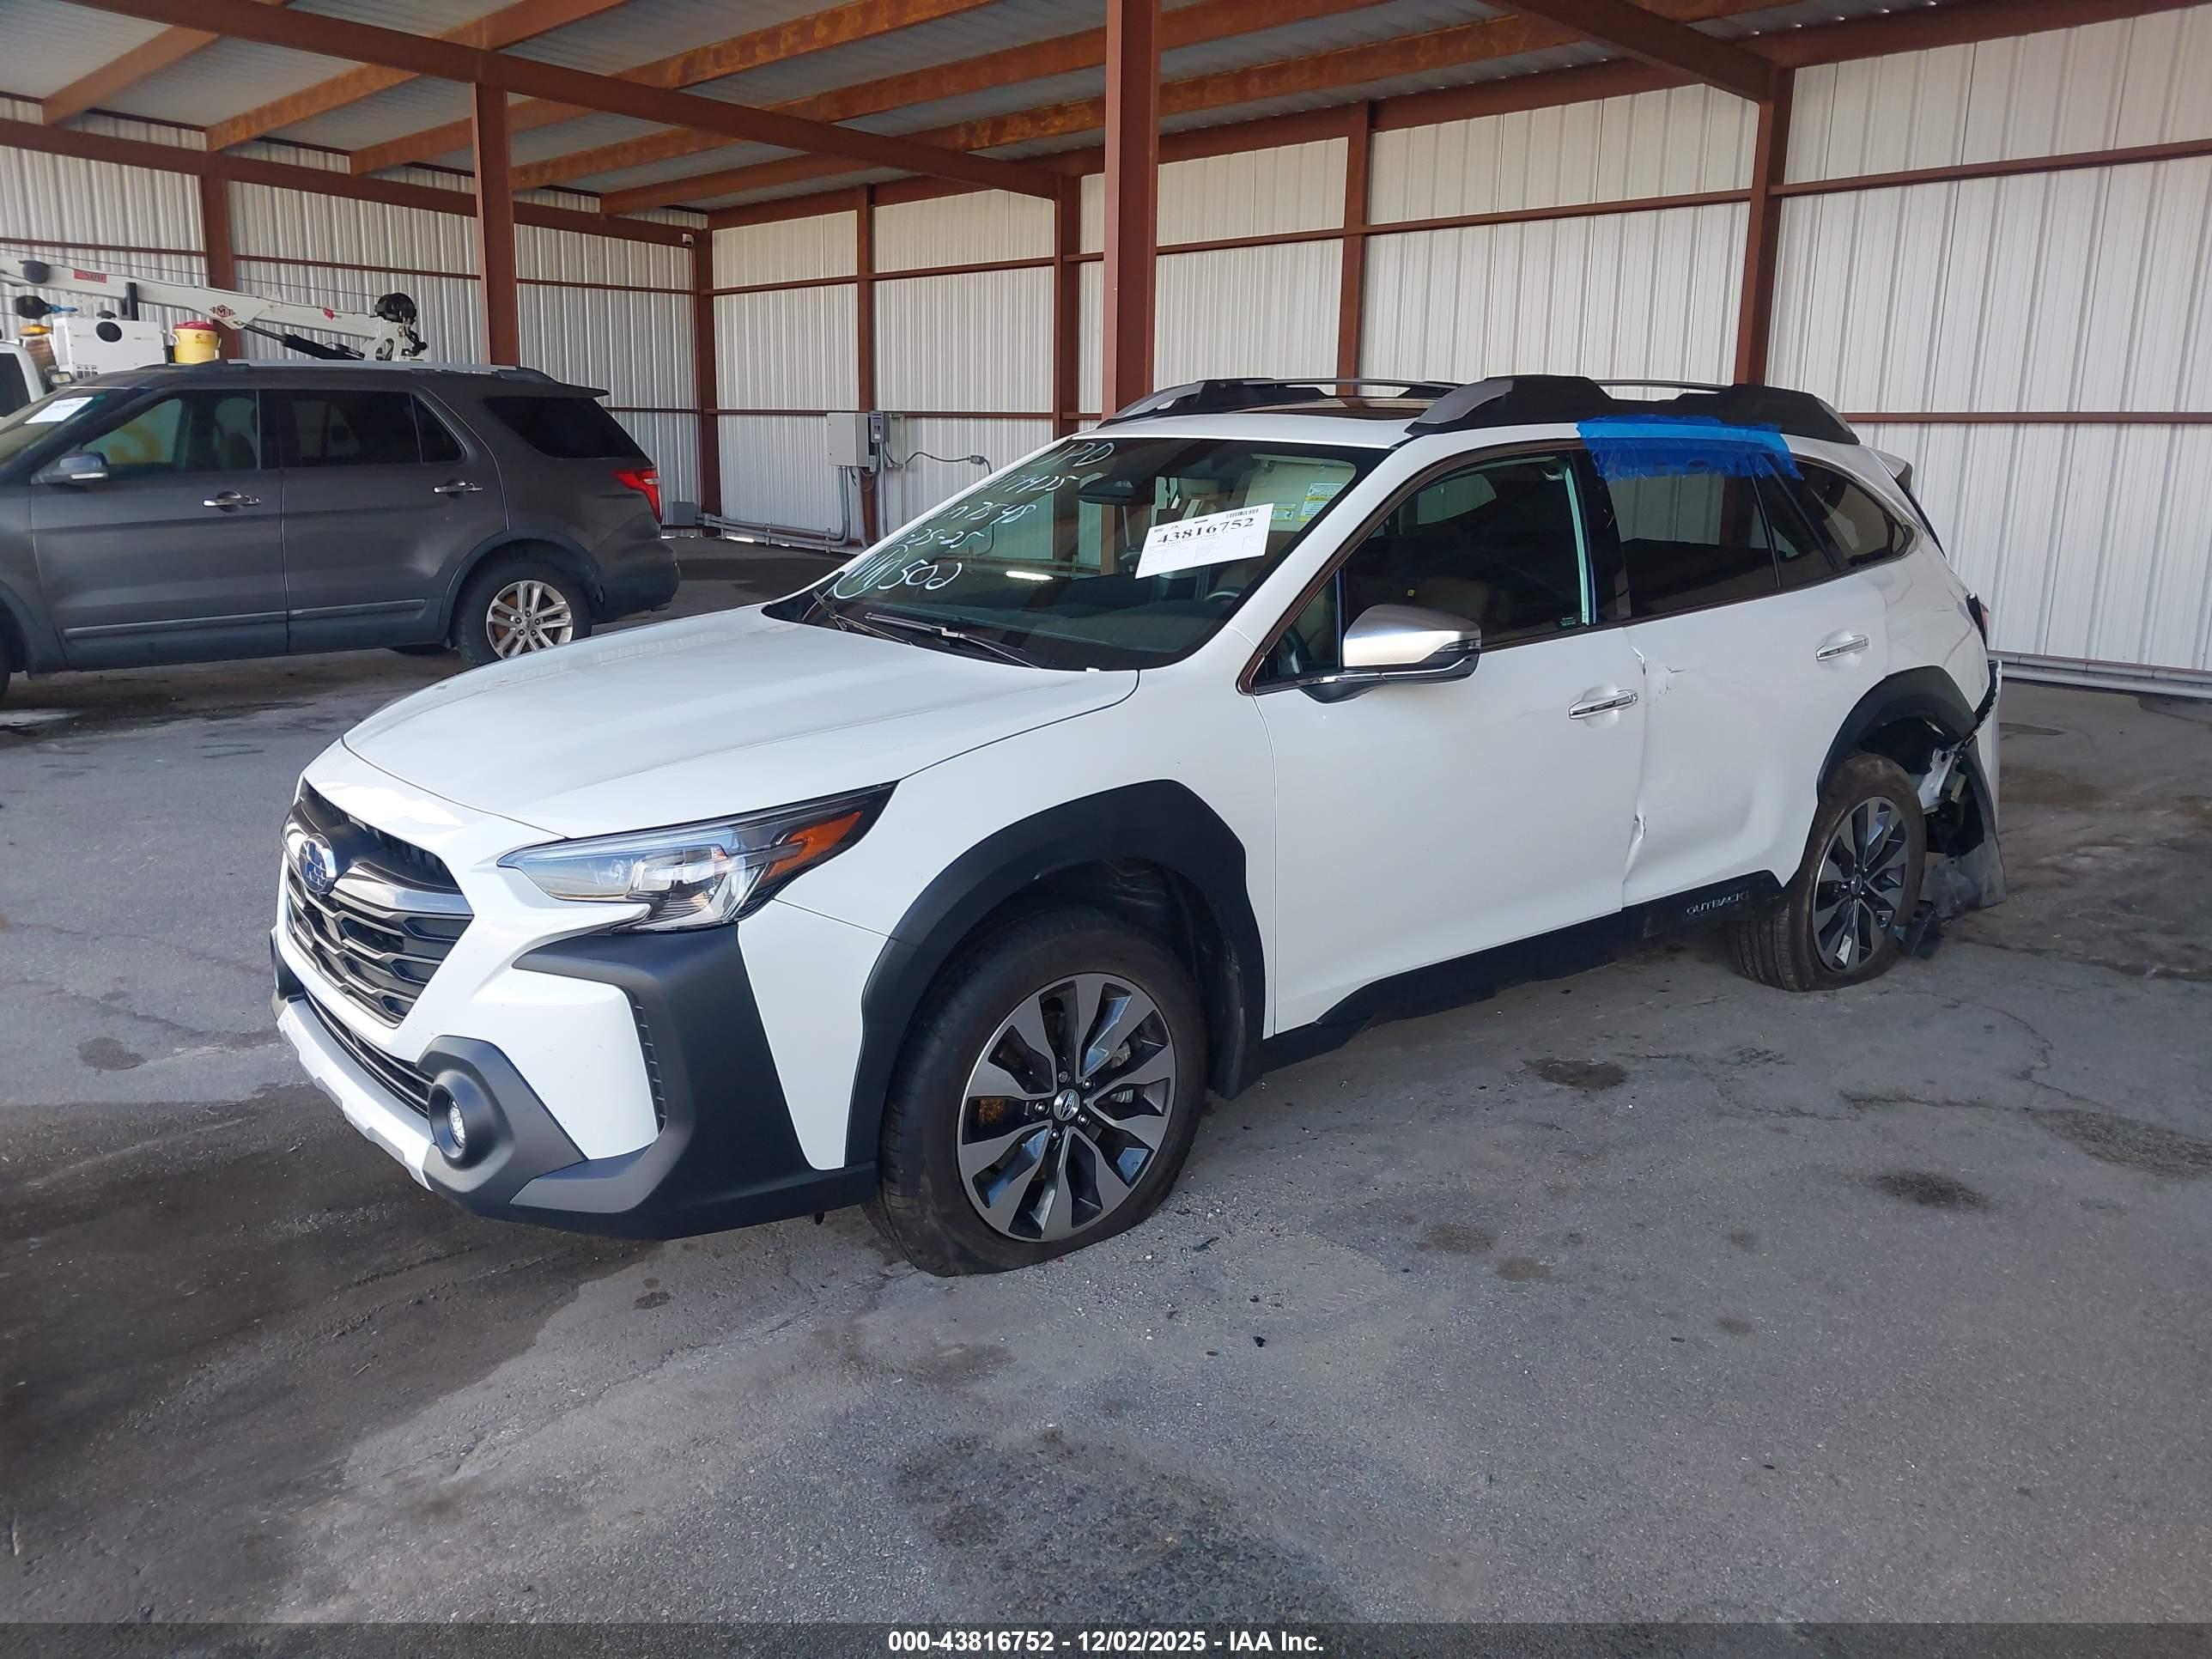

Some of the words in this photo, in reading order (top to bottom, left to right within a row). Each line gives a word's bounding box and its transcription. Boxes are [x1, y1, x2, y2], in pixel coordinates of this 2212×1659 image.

[1157, 517, 1255, 544] 43816752
[878, 559, 963, 590] 502
[1686, 890, 1748, 916] OUTBACK
